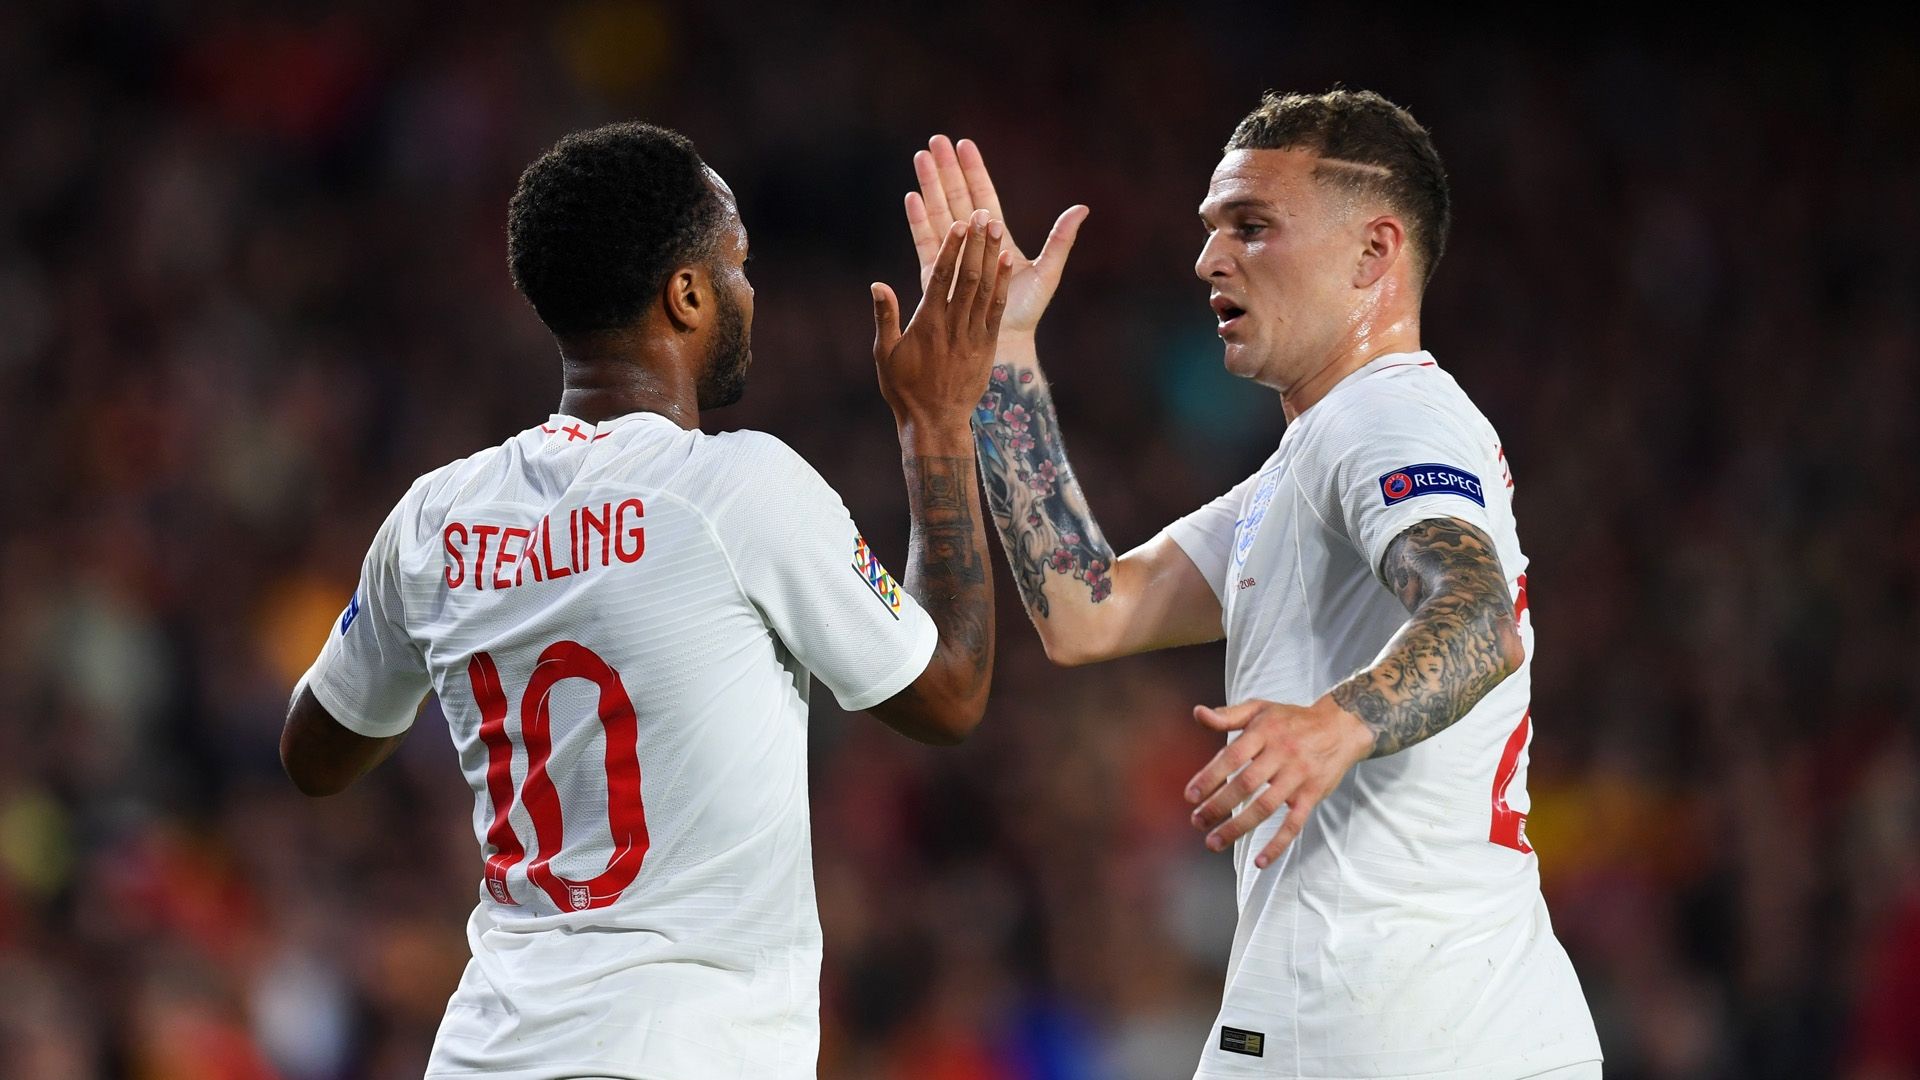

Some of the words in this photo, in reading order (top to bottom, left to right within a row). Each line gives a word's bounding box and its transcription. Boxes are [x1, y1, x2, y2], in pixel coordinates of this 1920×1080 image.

[1414, 472, 1482, 497] RESPECT
[443, 498, 645, 591] STERLING
[467, 640, 650, 913] 10
